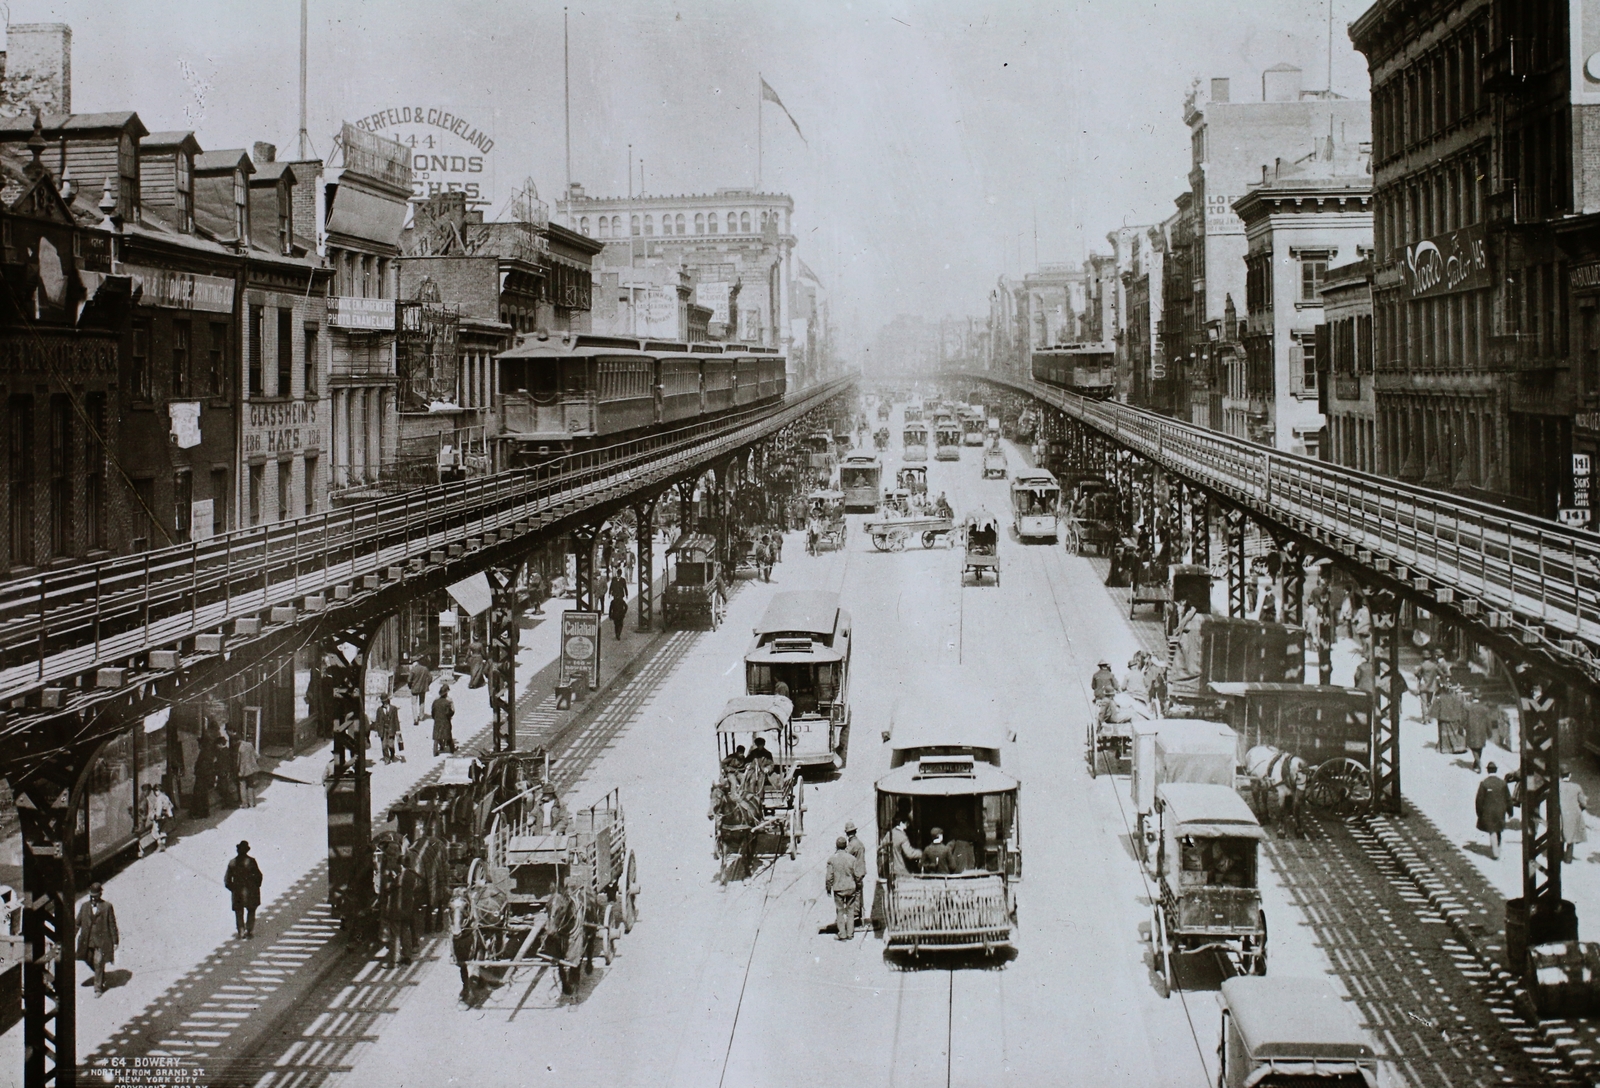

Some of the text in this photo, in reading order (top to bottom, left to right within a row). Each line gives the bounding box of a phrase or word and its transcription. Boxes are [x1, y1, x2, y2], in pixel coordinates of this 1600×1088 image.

[414, 107, 425, 123] &
[427, 108, 495, 155] CLEVELAND
[1207, 206, 1225, 215] TO
[1406, 240, 1444, 297] Nicoll
[1446, 250, 1471, 290] Tailor
[328, 313, 351, 325] PHOTO
[352, 314, 395, 328] ENAMELING
[251, 402, 316, 427] GLASSHEIM'S
[1574, 457, 1589, 469] 141
[1573, 477, 1590, 489] SIGNS
[565, 621, 595, 636] Callahan
